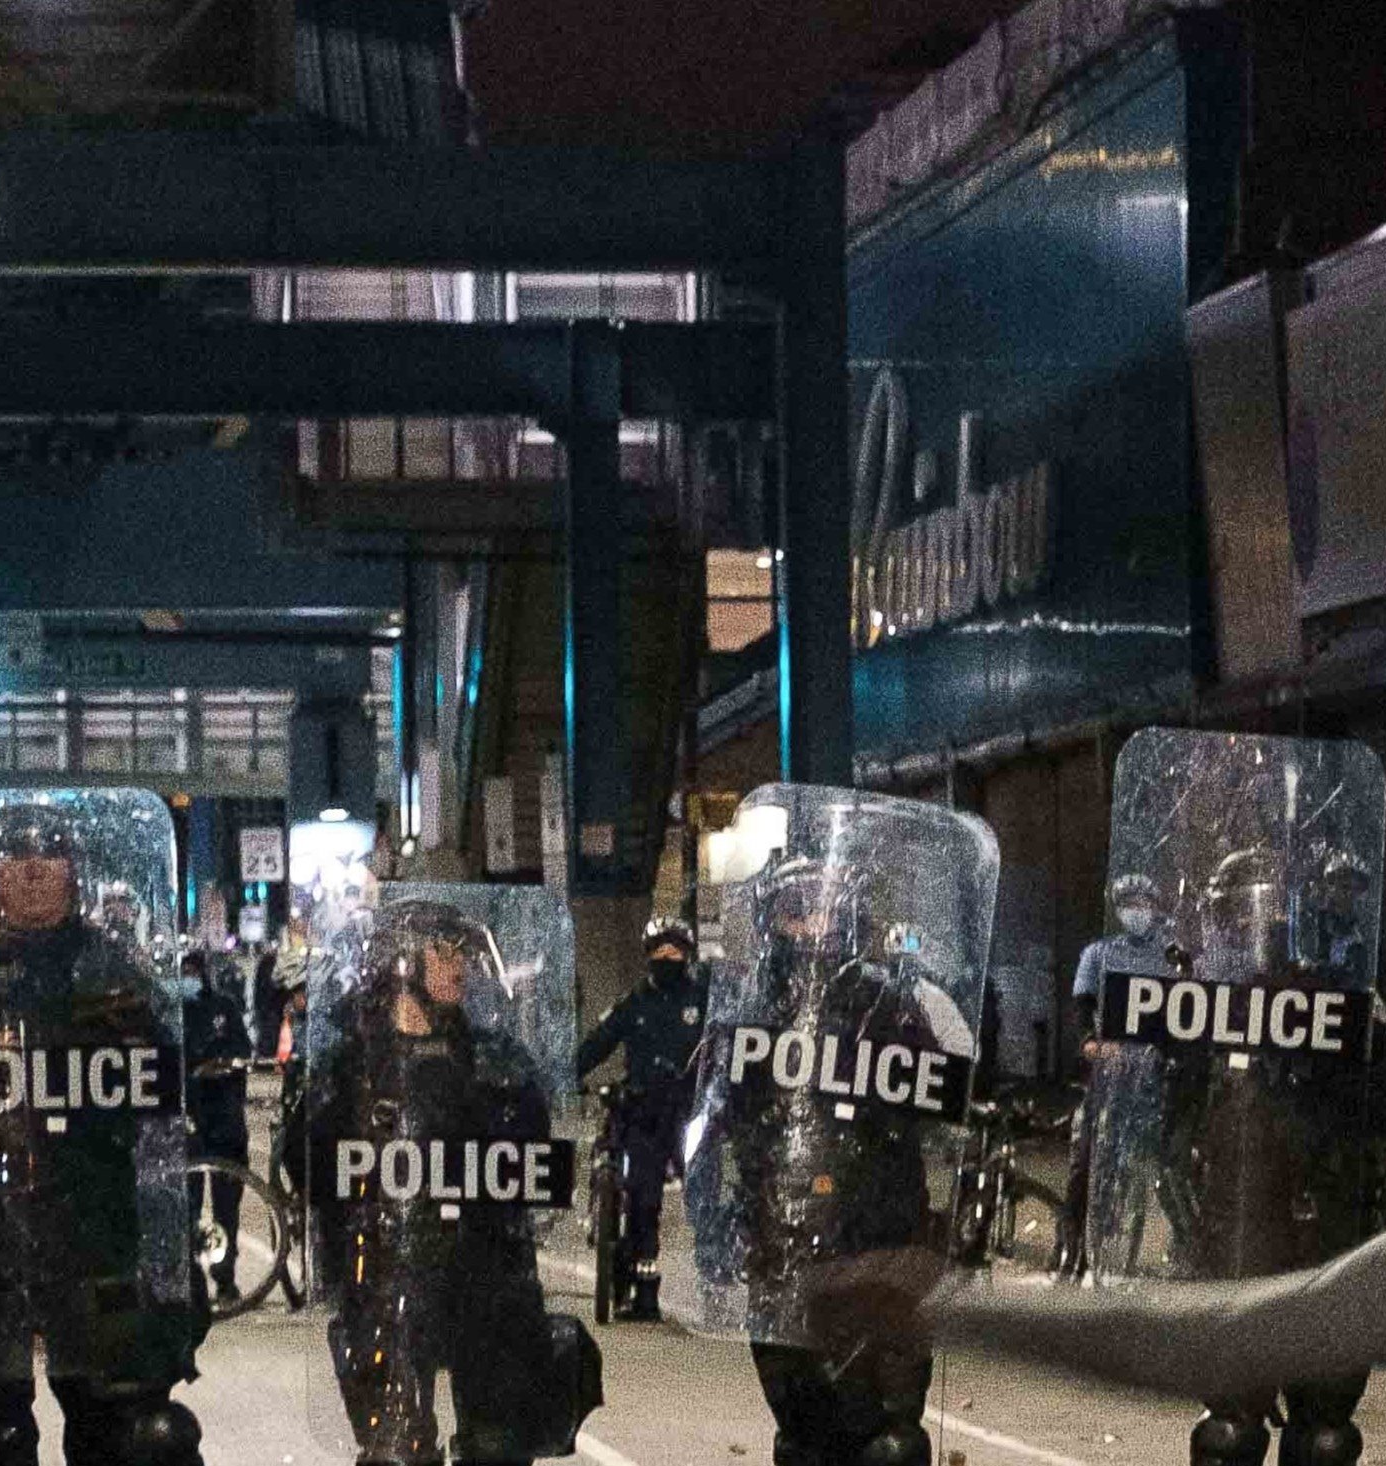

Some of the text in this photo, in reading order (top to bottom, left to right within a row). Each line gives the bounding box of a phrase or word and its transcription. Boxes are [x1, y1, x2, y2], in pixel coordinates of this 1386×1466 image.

[1126, 977, 1346, 1050] POLICE
[729, 1027, 947, 1111] POLICE
[337, 1139, 552, 1201] POLICE
